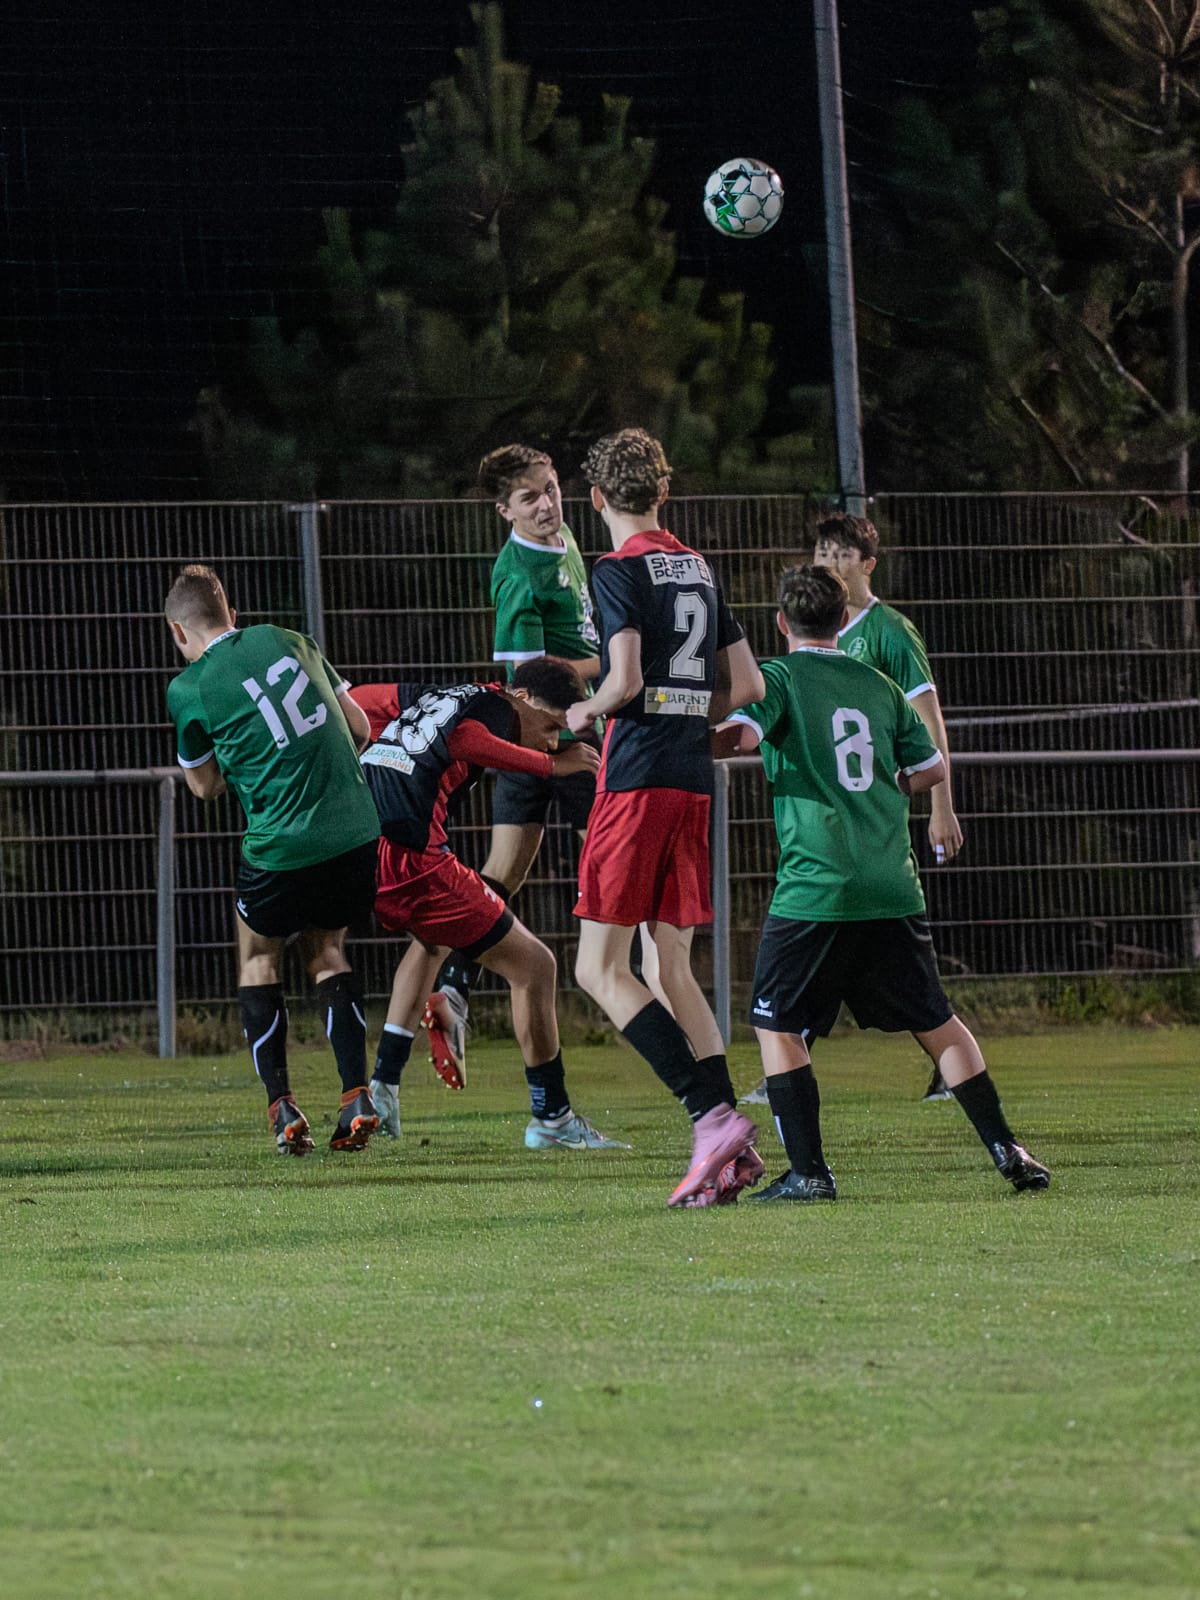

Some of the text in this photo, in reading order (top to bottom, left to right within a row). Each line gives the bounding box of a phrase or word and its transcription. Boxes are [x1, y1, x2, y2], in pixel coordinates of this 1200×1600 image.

[670, 591, 708, 681] 2
[241, 655, 327, 750] 12
[832, 708, 874, 791] 8
